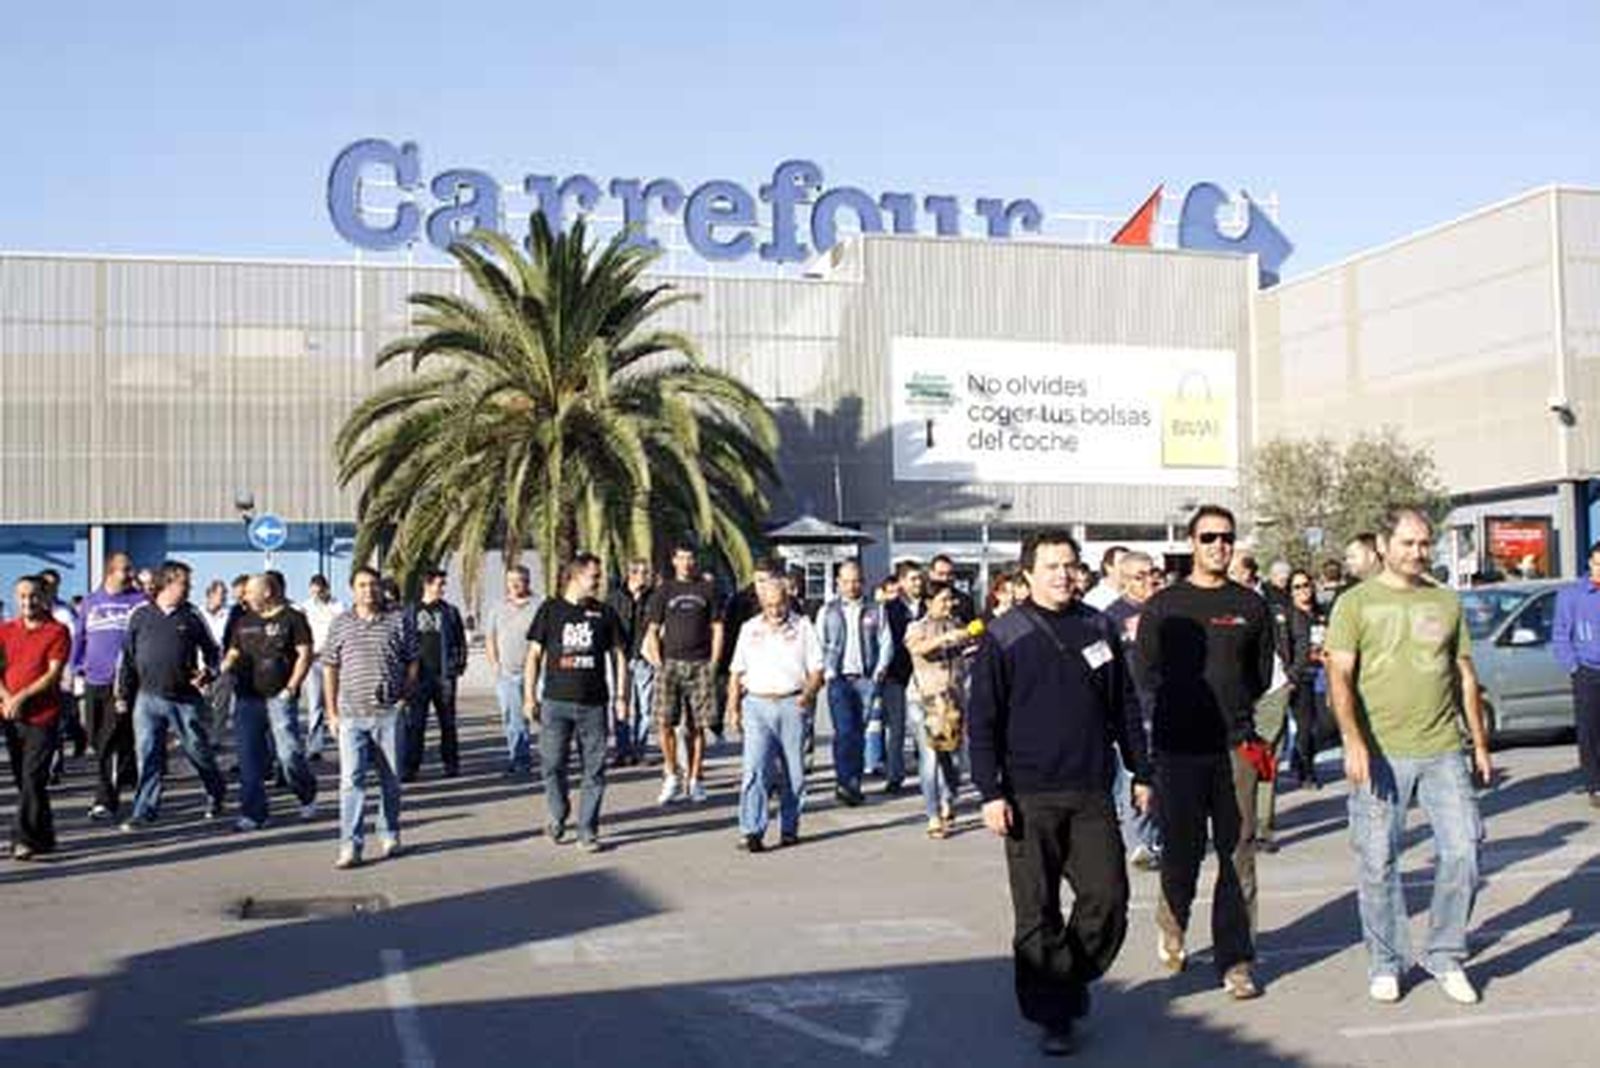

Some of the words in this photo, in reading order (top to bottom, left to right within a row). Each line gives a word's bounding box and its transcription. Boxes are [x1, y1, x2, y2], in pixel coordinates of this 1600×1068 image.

[326, 138, 1043, 264] Carrefour
[966, 374, 1002, 396] No
[1006, 374, 1087, 397] olvides
[967, 405, 1035, 427] coger
[1040, 404, 1076, 424] tus
[1080, 404, 1151, 427] bolsas
[967, 429, 1003, 451] del
[1008, 431, 1079, 452] coche
